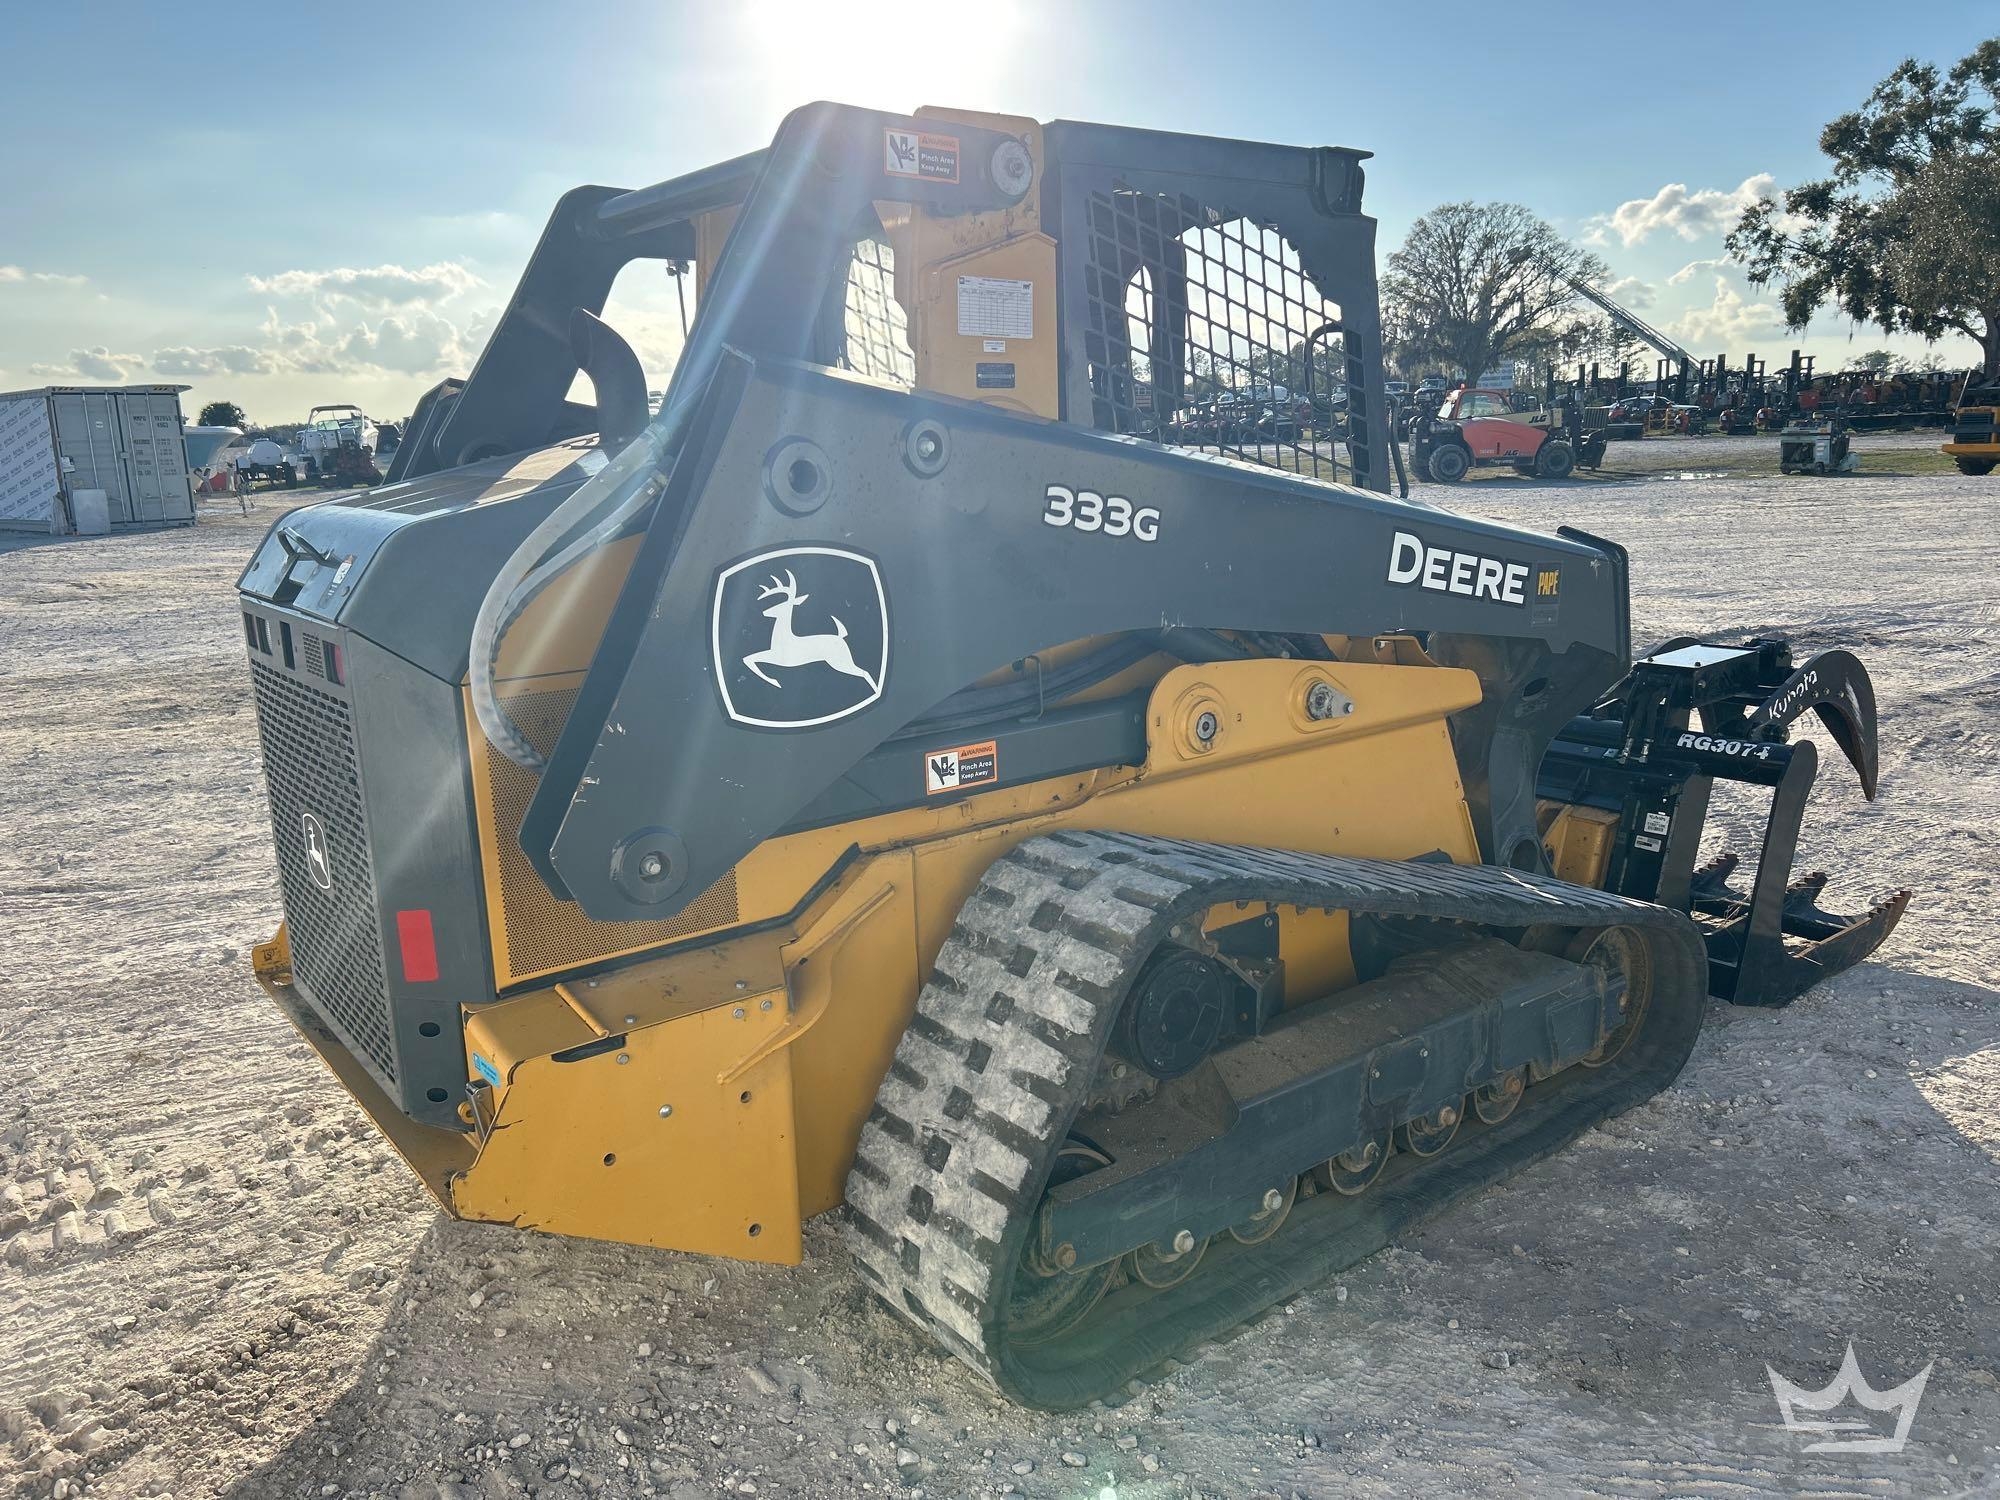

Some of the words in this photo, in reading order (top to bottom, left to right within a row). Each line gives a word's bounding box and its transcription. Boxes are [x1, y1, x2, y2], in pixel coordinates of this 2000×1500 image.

[921, 153, 939, 162] Pinch
[940, 156, 955, 165] Area
[935, 166, 951, 175] Away
[1529, 414, 1547, 424] JLG
[1044, 486, 1160, 541] 333G
[1387, 531, 1529, 604] DEERE
[1768, 670, 1818, 719] Kubota
[966, 746, 993, 755] WARNING
[1676, 733, 1771, 760] RG3074
[960, 762, 978, 771] Pinch
[978, 760, 993, 768] Area
